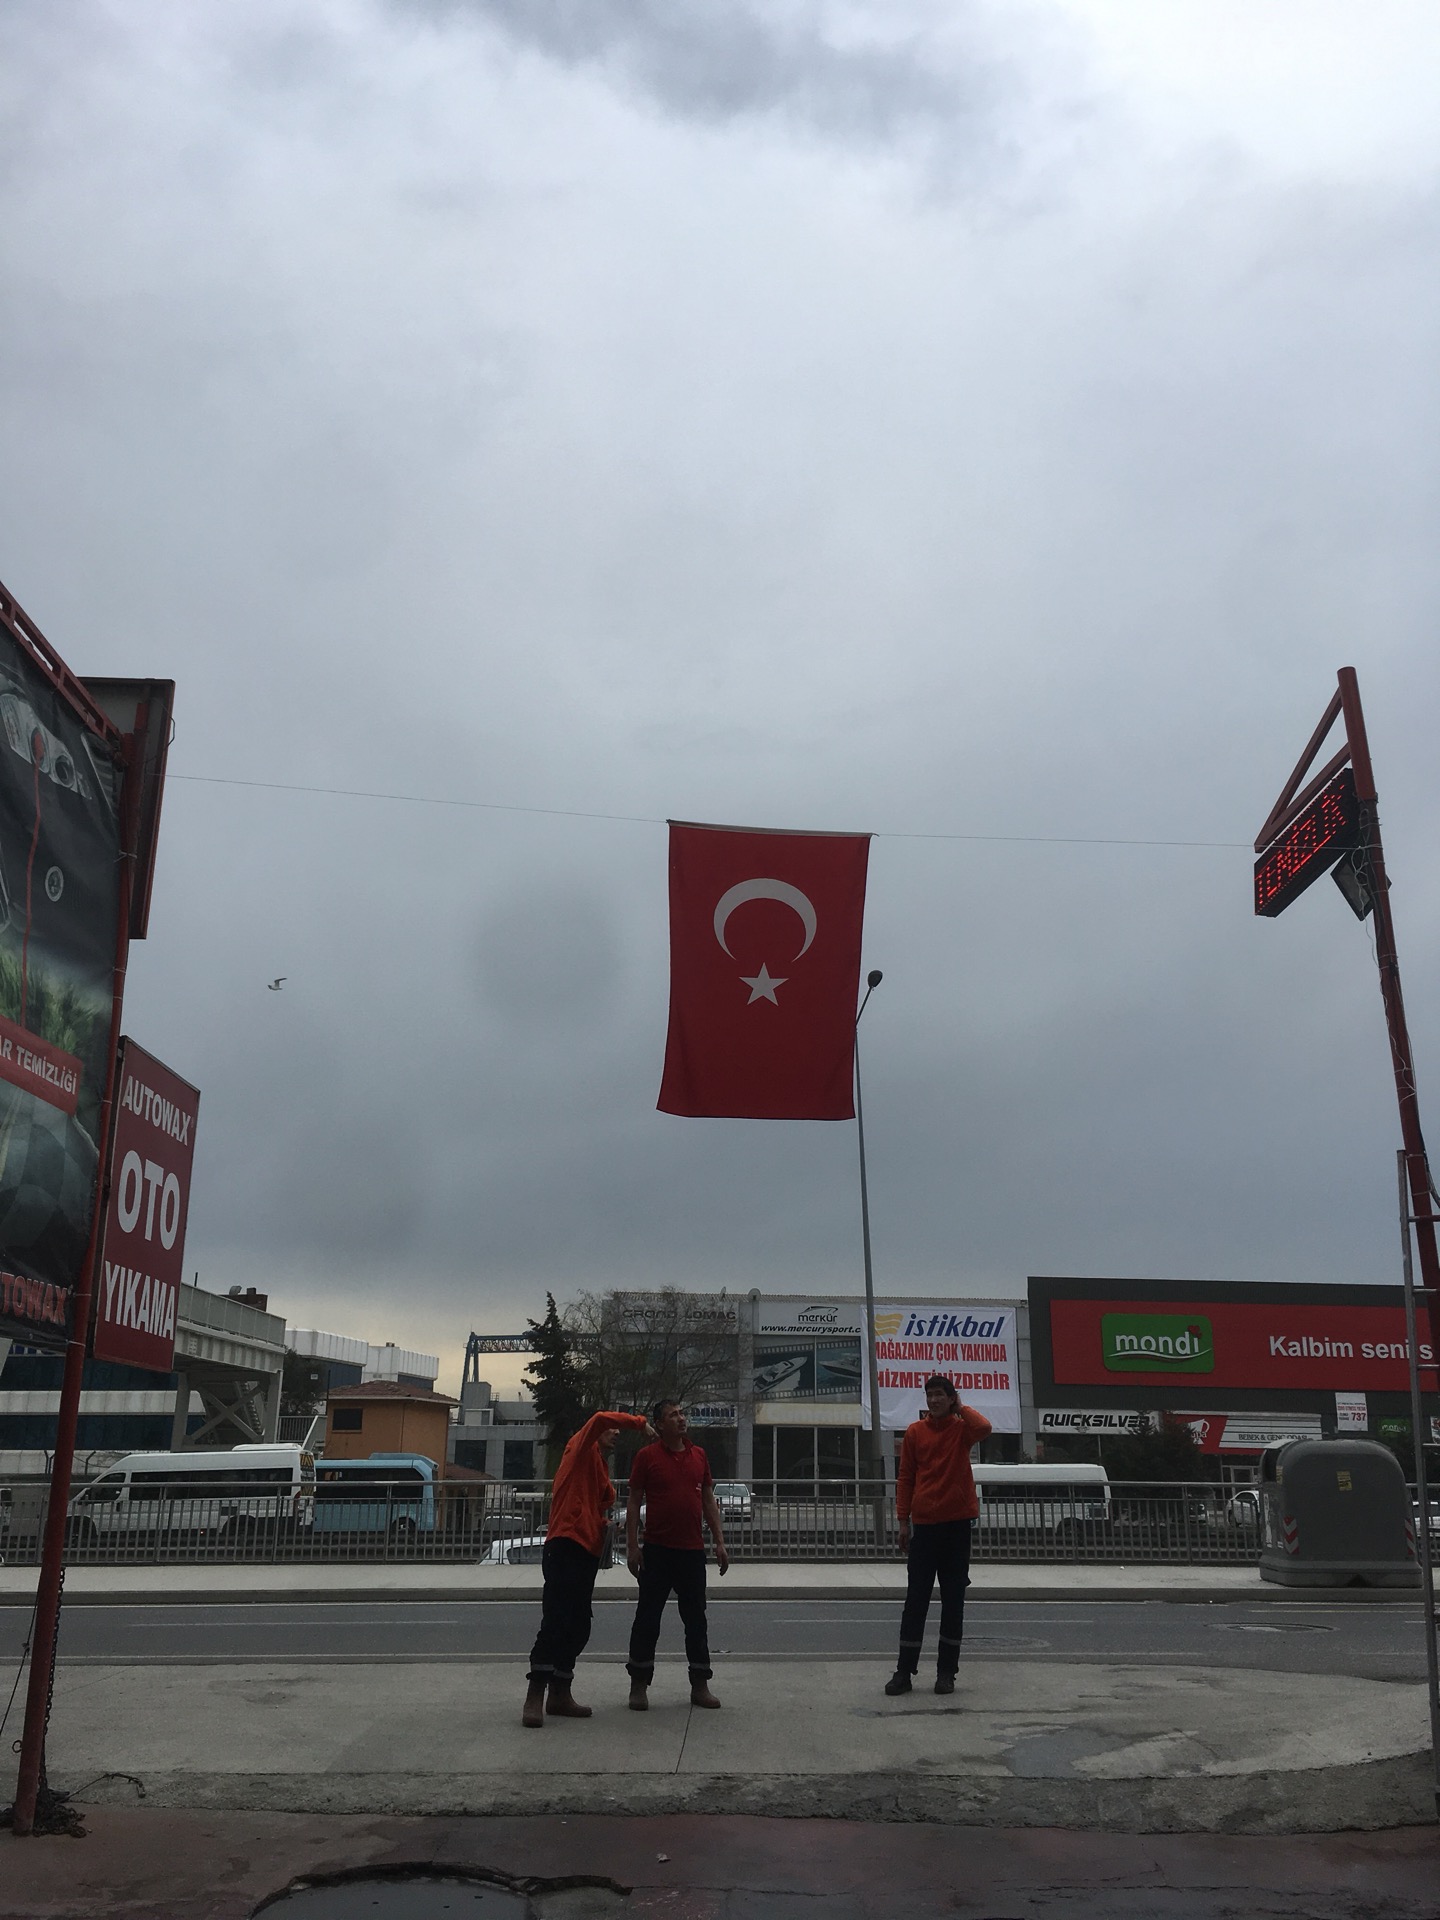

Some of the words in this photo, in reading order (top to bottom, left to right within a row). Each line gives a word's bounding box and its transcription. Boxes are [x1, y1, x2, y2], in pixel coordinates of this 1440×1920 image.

[0, 1034, 13, 1061] R
[16, 1044, 77, 1095] TEMİZLİĞİ
[122, 1075, 191, 1146] AUTOWAX
[117, 1150, 181, 1251] OTO
[0, 1270, 67, 1327] TOWAX
[105, 1260, 175, 1341] YIKAMA
[798, 1313, 838, 1322] merkür
[904, 1313, 1005, 1338] istikbal
[936, 1342, 958, 1364] ÇOK
[960, 1343, 1007, 1362] YAKINDA
[1115, 1331, 1200, 1355] mondi
[1269, 1336, 1354, 1358] Kalbim
[877, 1368, 1010, 1390] HİZMETİZDEDİR
[1042, 1413, 1150, 1428] QUICKSILVER
[1351, 1412, 1366, 1421] 737
